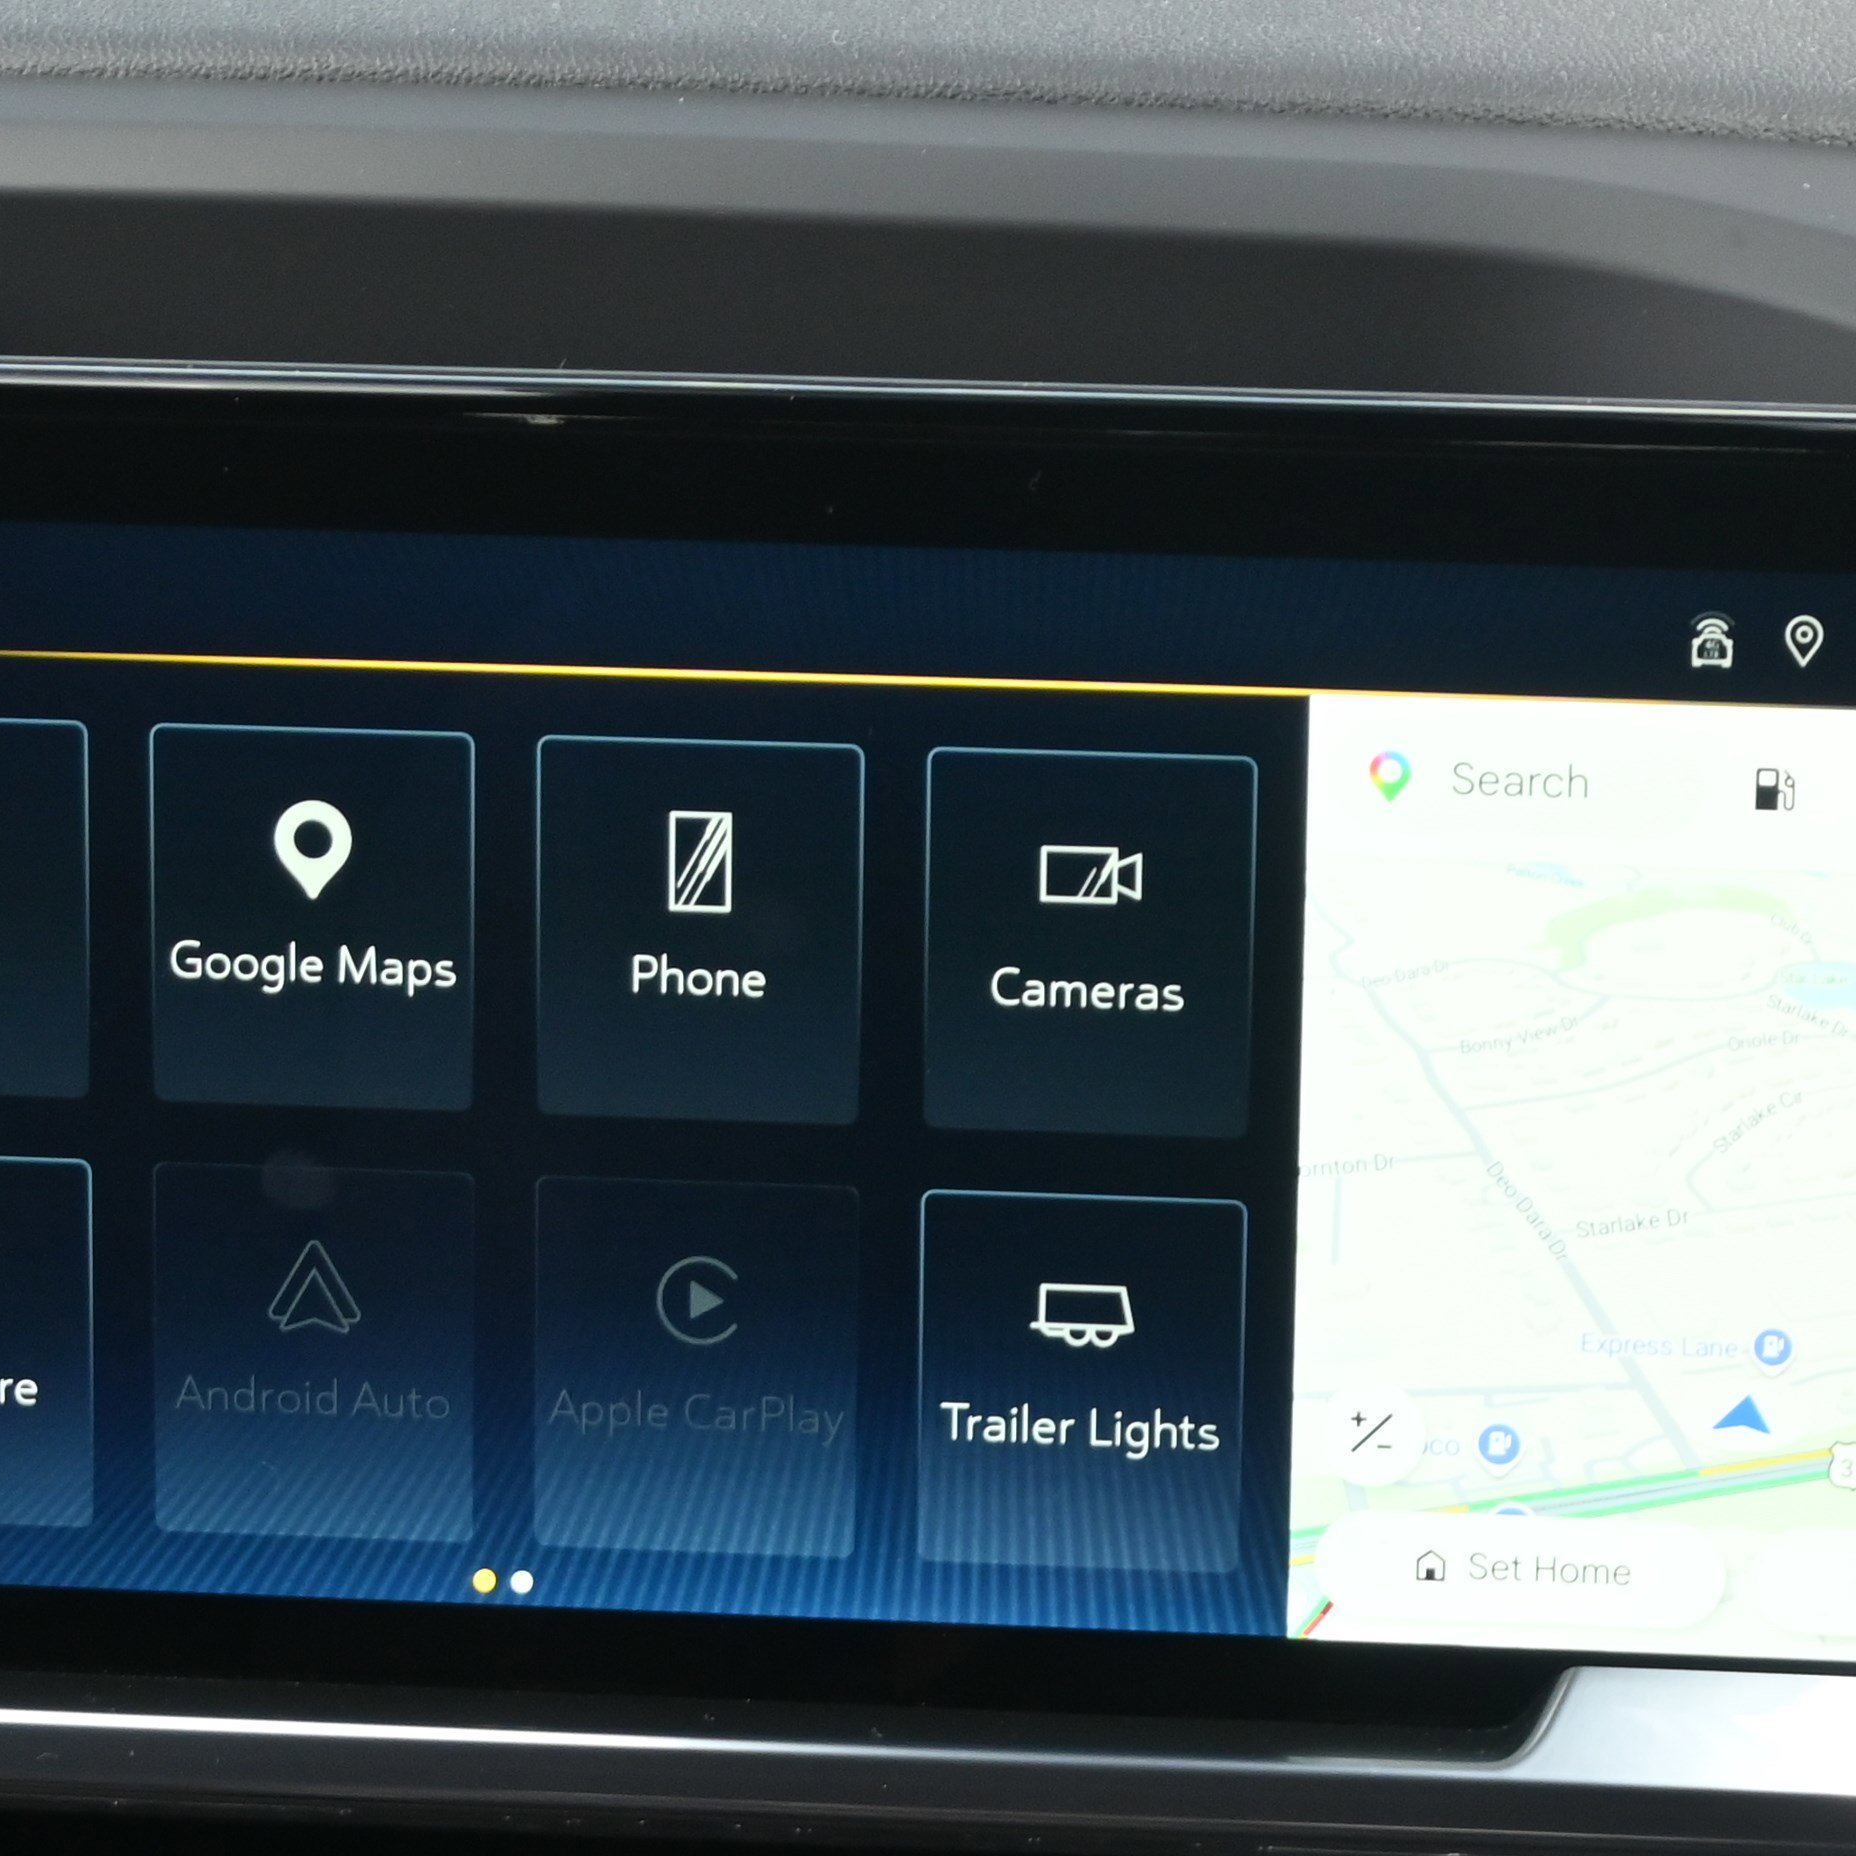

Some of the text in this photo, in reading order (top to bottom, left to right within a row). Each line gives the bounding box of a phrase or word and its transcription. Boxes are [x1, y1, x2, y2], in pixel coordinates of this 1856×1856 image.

[1452, 761, 1588, 799] Search
[169, 939, 457, 998] Google Maps
[631, 952, 767, 999] Phone
[990, 966, 1185, 1012] Cameras
[1712, 1103, 1777, 1154] Starlake
[1374, 1153, 1396, 1171] Dr
[1486, 1159, 1517, 1199] Deo
[1514, 1195, 1552, 1243] Dara
[1576, 1209, 1689, 1239] Starlake Dr
[1581, 1332, 1739, 1359] Express Lane
[174, 1375, 450, 1420] Android Auto
[548, 1388, 844, 1447] Apple CarPlay
[939, 1401, 1220, 1461] Trailer Lights
[1469, 1553, 1632, 1585] Set Home
